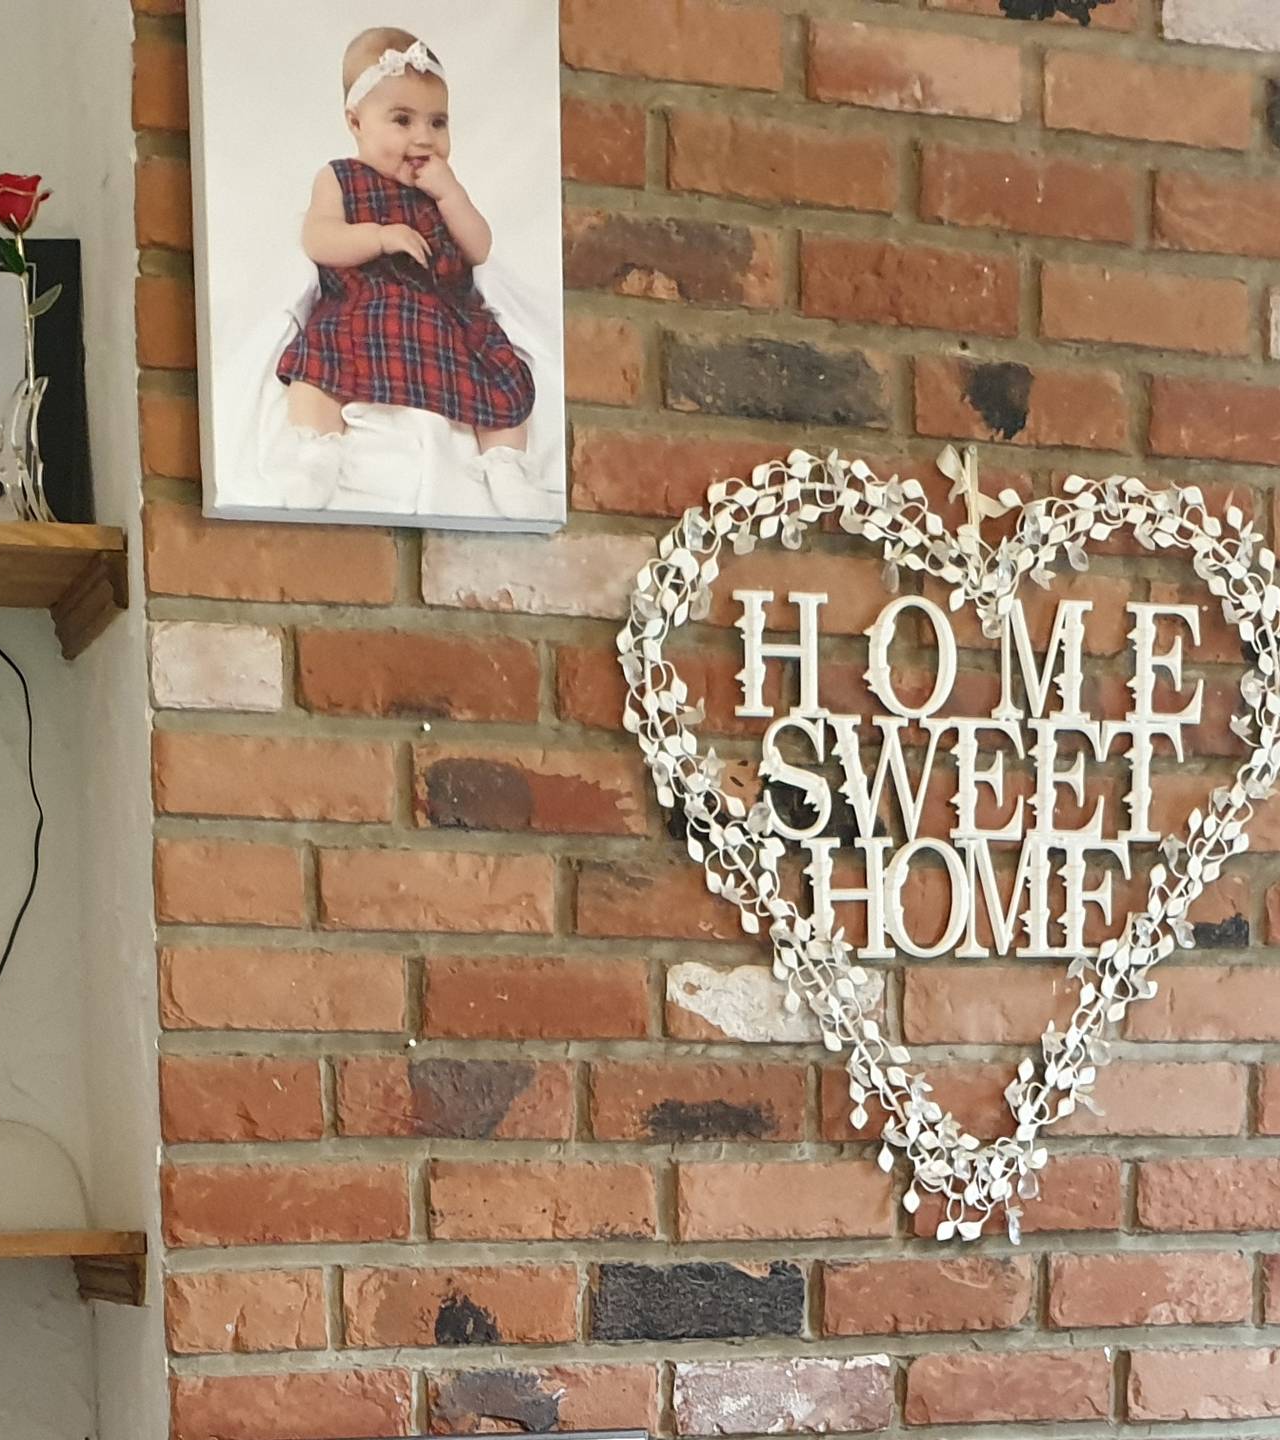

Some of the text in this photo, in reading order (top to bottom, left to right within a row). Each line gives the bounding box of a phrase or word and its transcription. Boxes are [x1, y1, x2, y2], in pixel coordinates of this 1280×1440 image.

[733, 589, 1204, 725] HOME
[760, 715, 1185, 841] SWEET
[801, 837, 1135, 959] HOME
